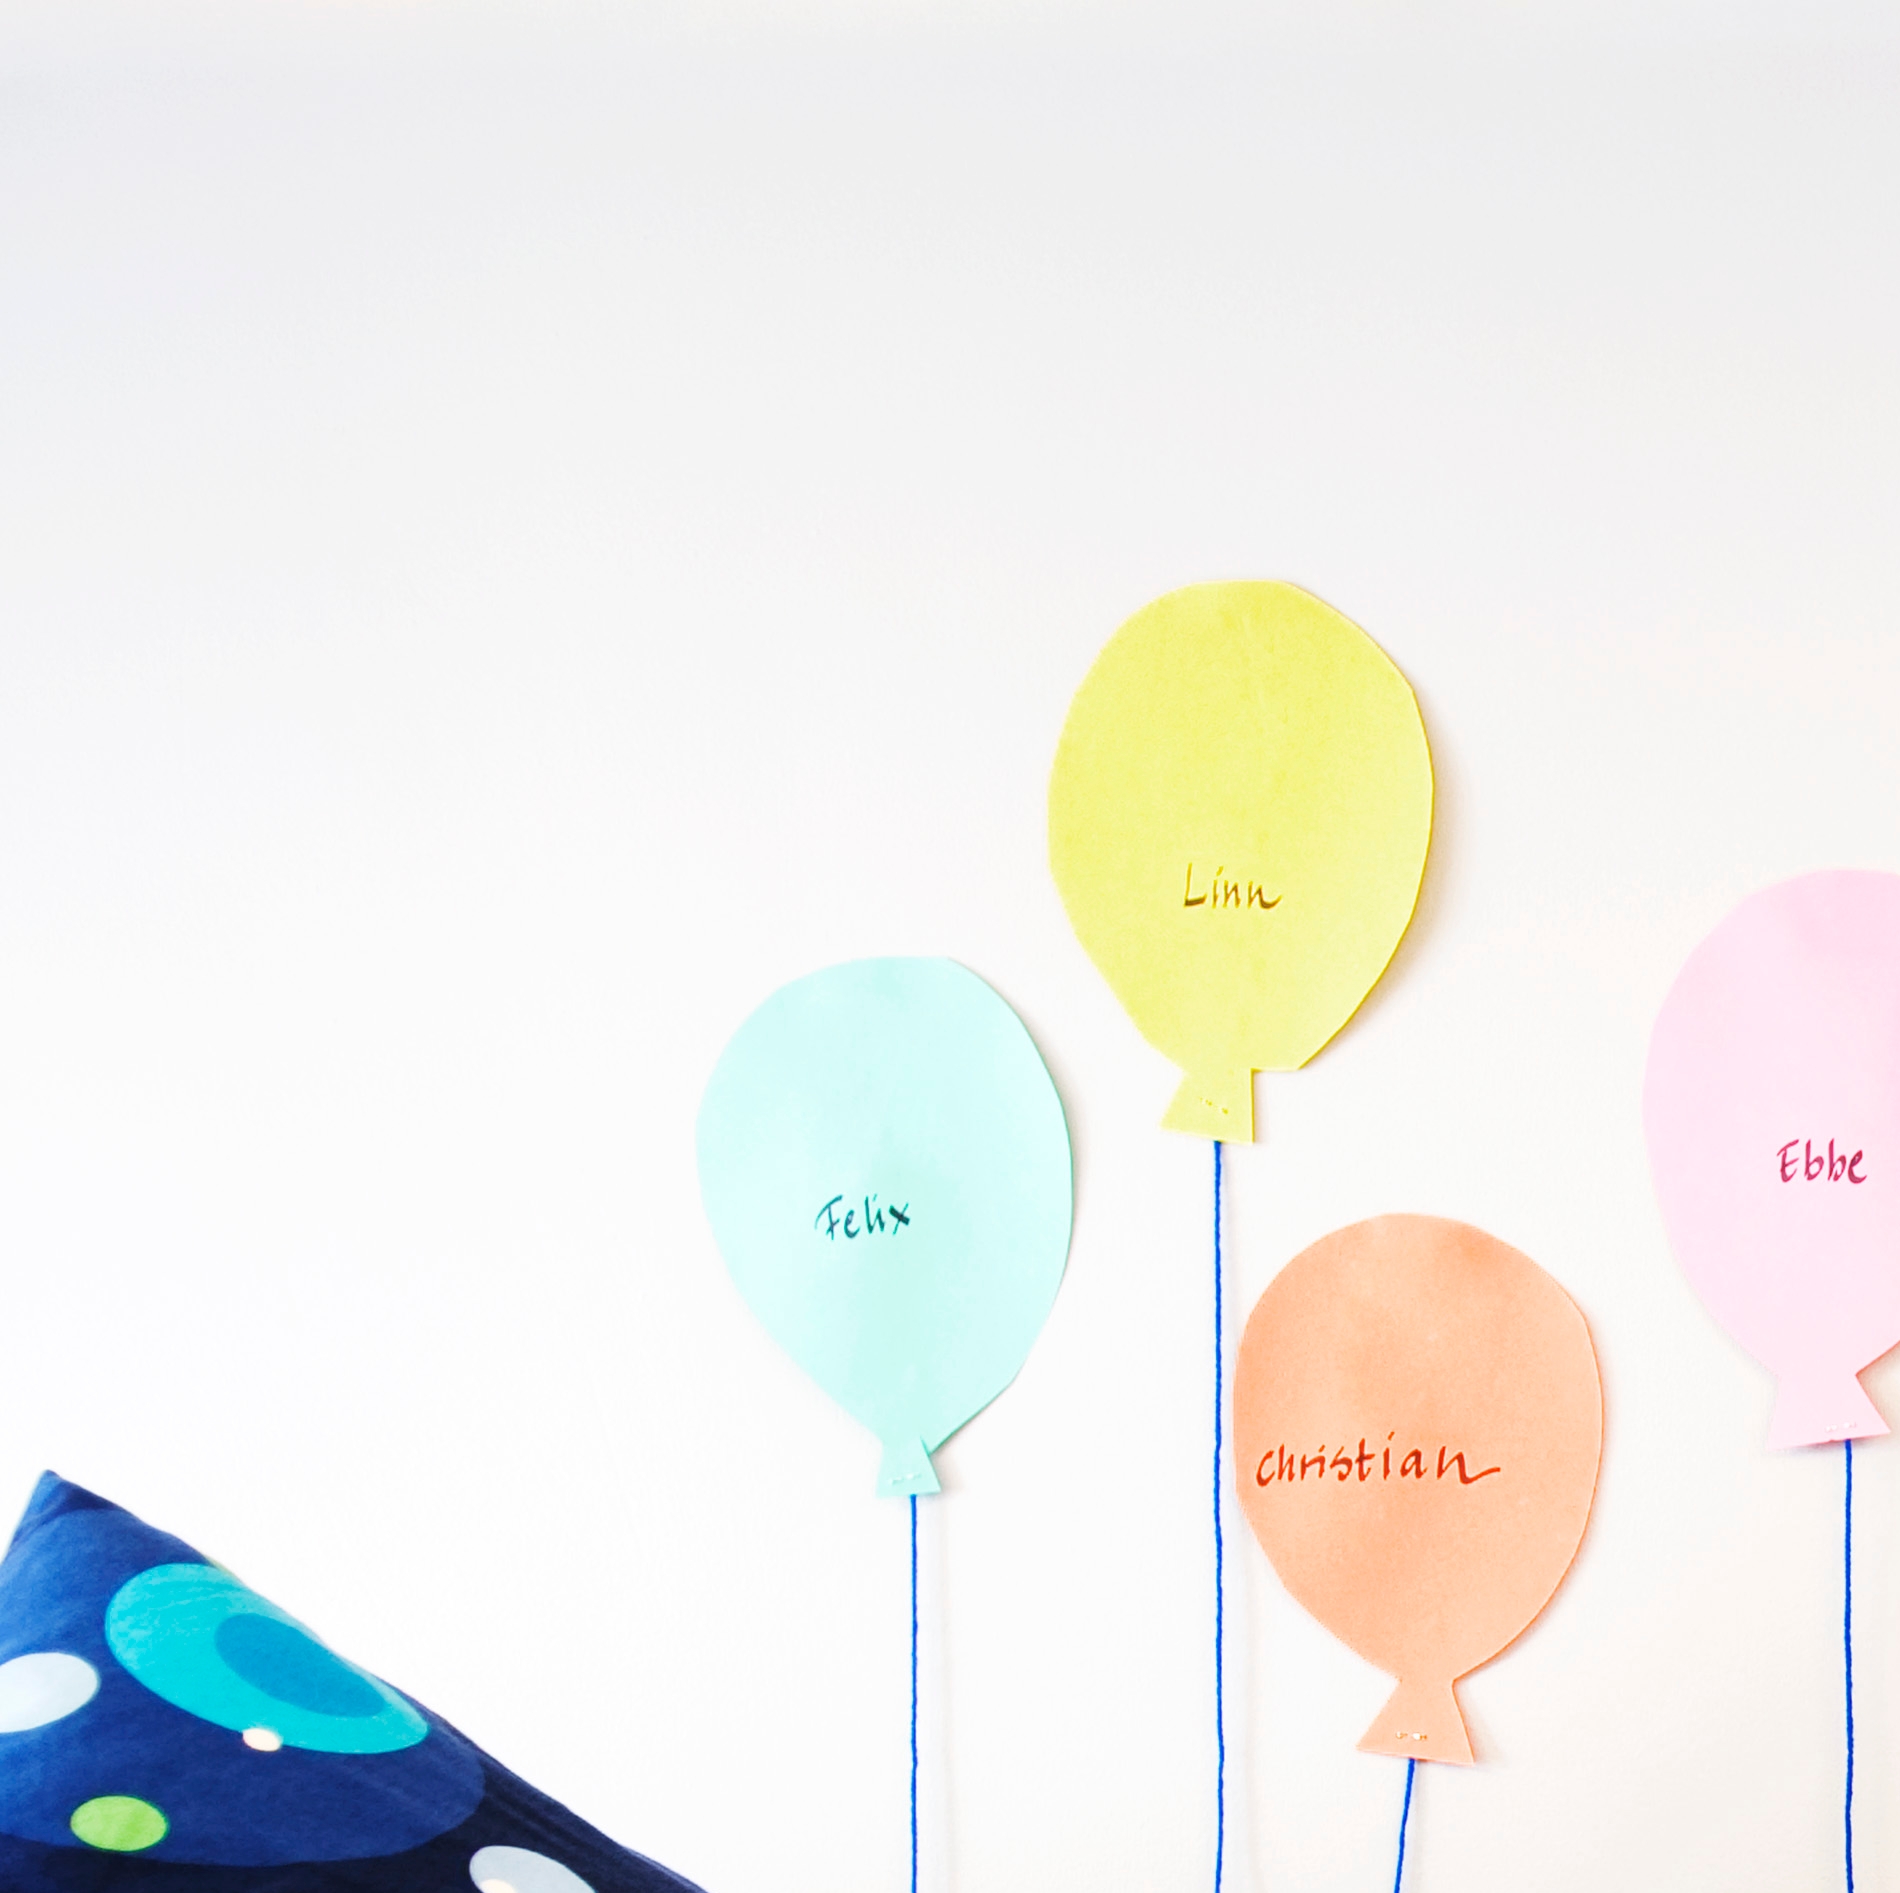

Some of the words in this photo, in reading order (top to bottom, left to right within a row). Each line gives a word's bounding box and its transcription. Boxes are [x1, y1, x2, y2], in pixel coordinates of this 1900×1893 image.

[1182, 860, 1283, 910] Linn
[1776, 1137, 1868, 1185] Ebbe
[814, 1193, 911, 1241] Felix
